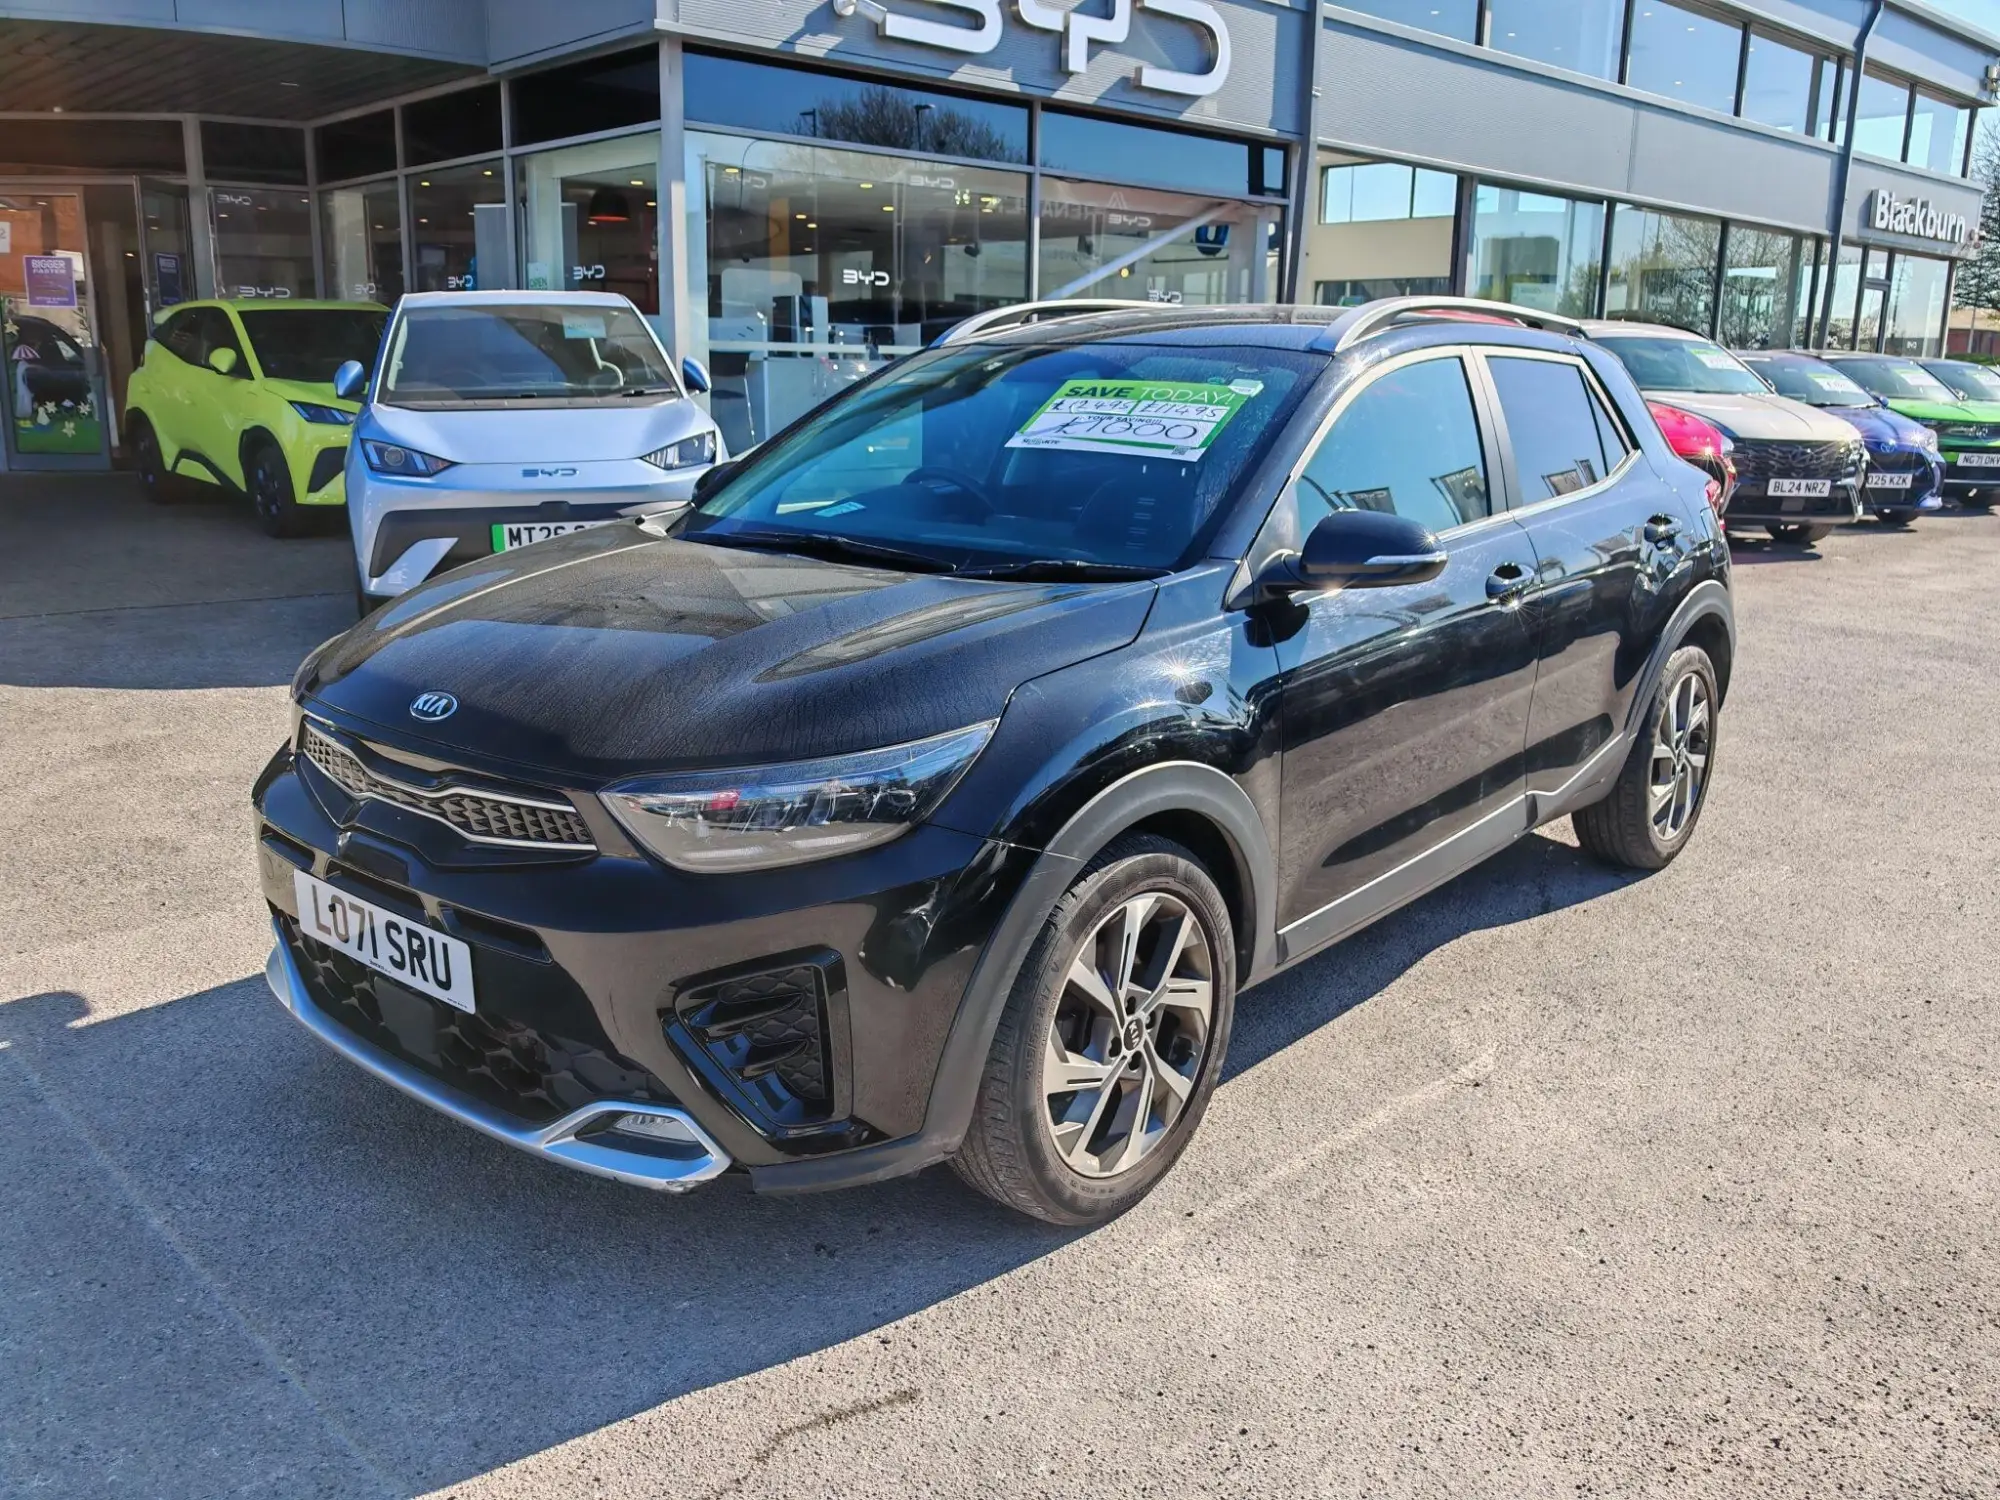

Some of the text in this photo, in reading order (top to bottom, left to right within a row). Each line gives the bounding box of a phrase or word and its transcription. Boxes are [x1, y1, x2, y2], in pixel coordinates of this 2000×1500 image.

[880, 0, 1231, 96] BYD
[1108, 213, 1152, 227] BYD
[1874, 188, 1966, 243] Blackburn
[573, 264, 606, 280] BYD
[843, 268, 890, 286] BYD
[448, 274, 473, 289] BYD
[239, 285, 291, 298] BYD
[1064, 386, 1135, 398] SAVE
[1139, 387, 1236, 405] TODAY!
[522, 467, 578, 478] BYD
[1889, 475, 1908, 486] KZK
[1773, 481, 1826, 494] BL24 NRZ
[413, 693, 449, 716] KIA
[385, 918, 452, 992] SRU
